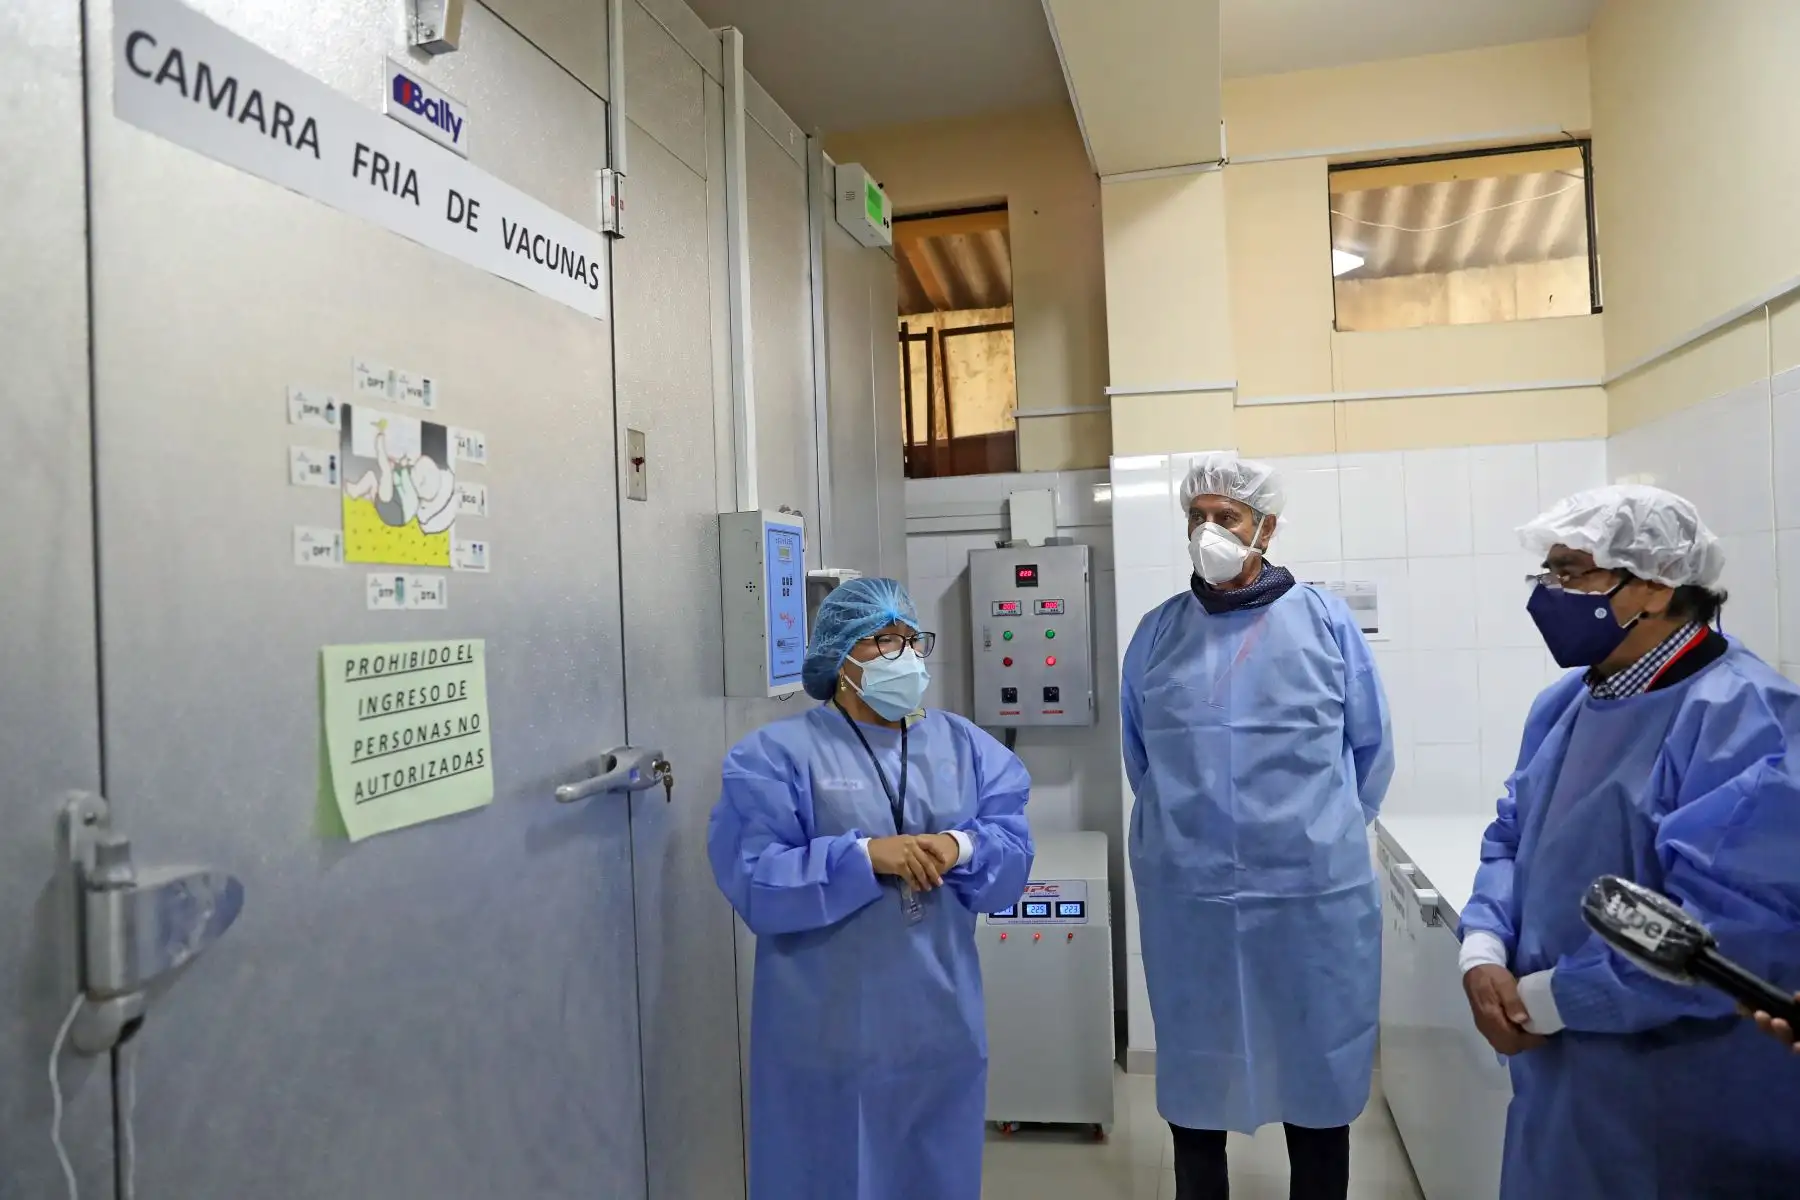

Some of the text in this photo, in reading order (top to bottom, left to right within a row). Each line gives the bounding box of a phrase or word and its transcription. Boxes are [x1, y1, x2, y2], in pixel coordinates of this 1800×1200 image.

[405, 77, 464, 144] Bally
[125, 30, 600, 291] CAMARA FRIA DE VACUNAS
[345, 644, 473, 678] PROHIBIDO EL
[358, 680, 467, 716] INGRESO DE
[354, 713, 480, 758] PERSONAS NO
[354, 748, 485, 801] AUTORIZADAS
